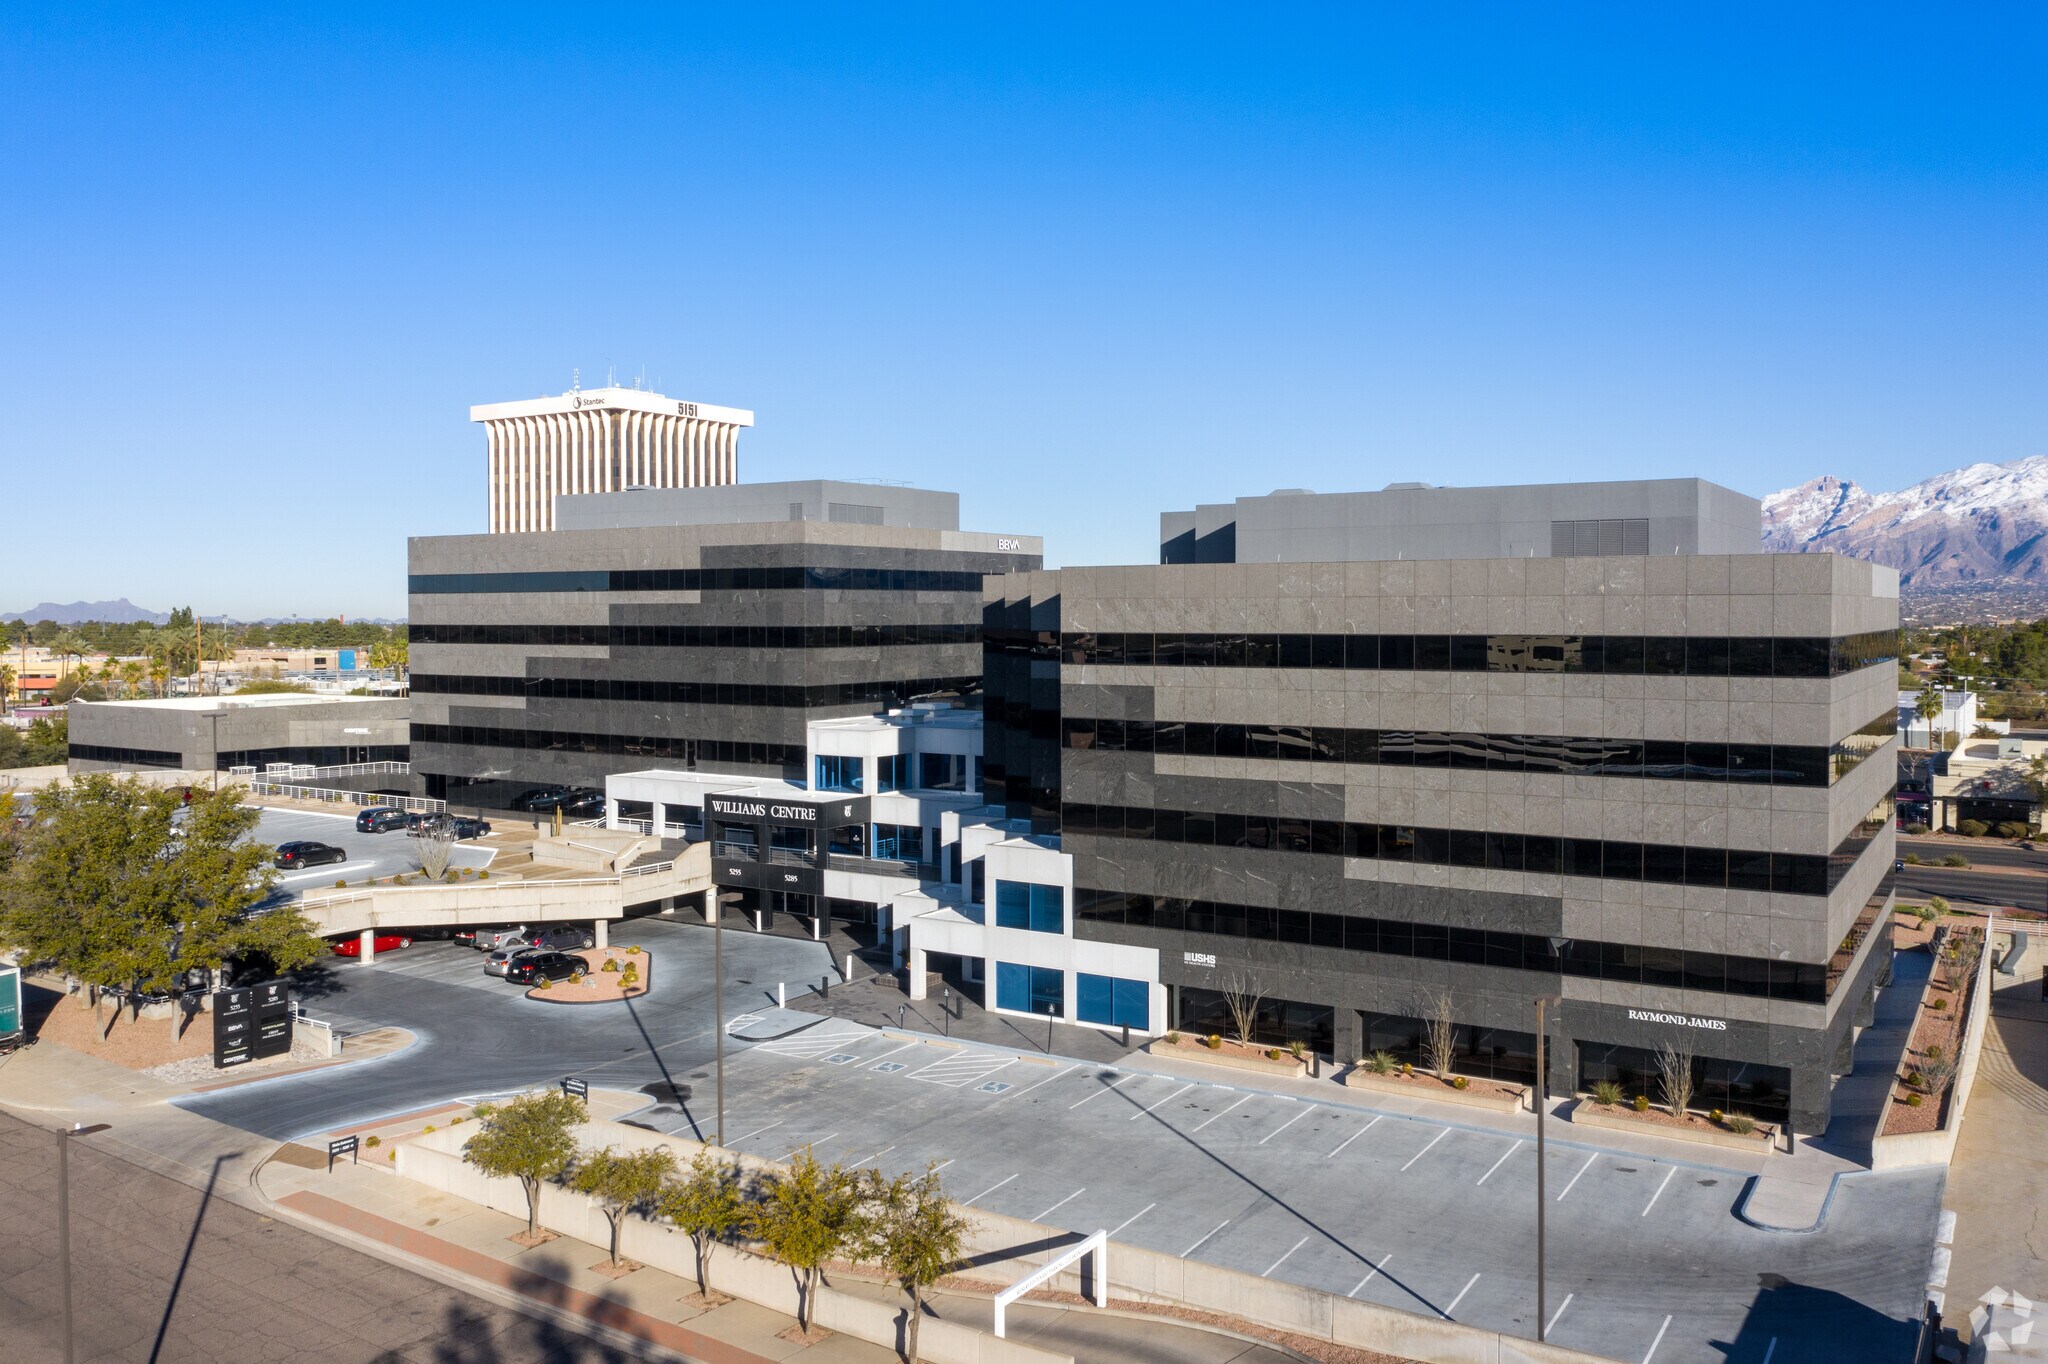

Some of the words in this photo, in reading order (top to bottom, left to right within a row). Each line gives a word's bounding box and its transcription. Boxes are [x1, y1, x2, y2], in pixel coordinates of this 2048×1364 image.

[583, 398, 604, 406] Stantec
[678, 402, 698, 417] 5151
[998, 538, 1020, 550] BBVA
[712, 800, 766, 816] WILLIAMS
[770, 806, 816, 820] CENTRE
[729, 868, 742, 876] 5255
[1192, 952, 1216, 964] USHS
[1628, 1010, 1686, 1025] RAYMOND
[1688, 1017, 1726, 1030] JAMES
